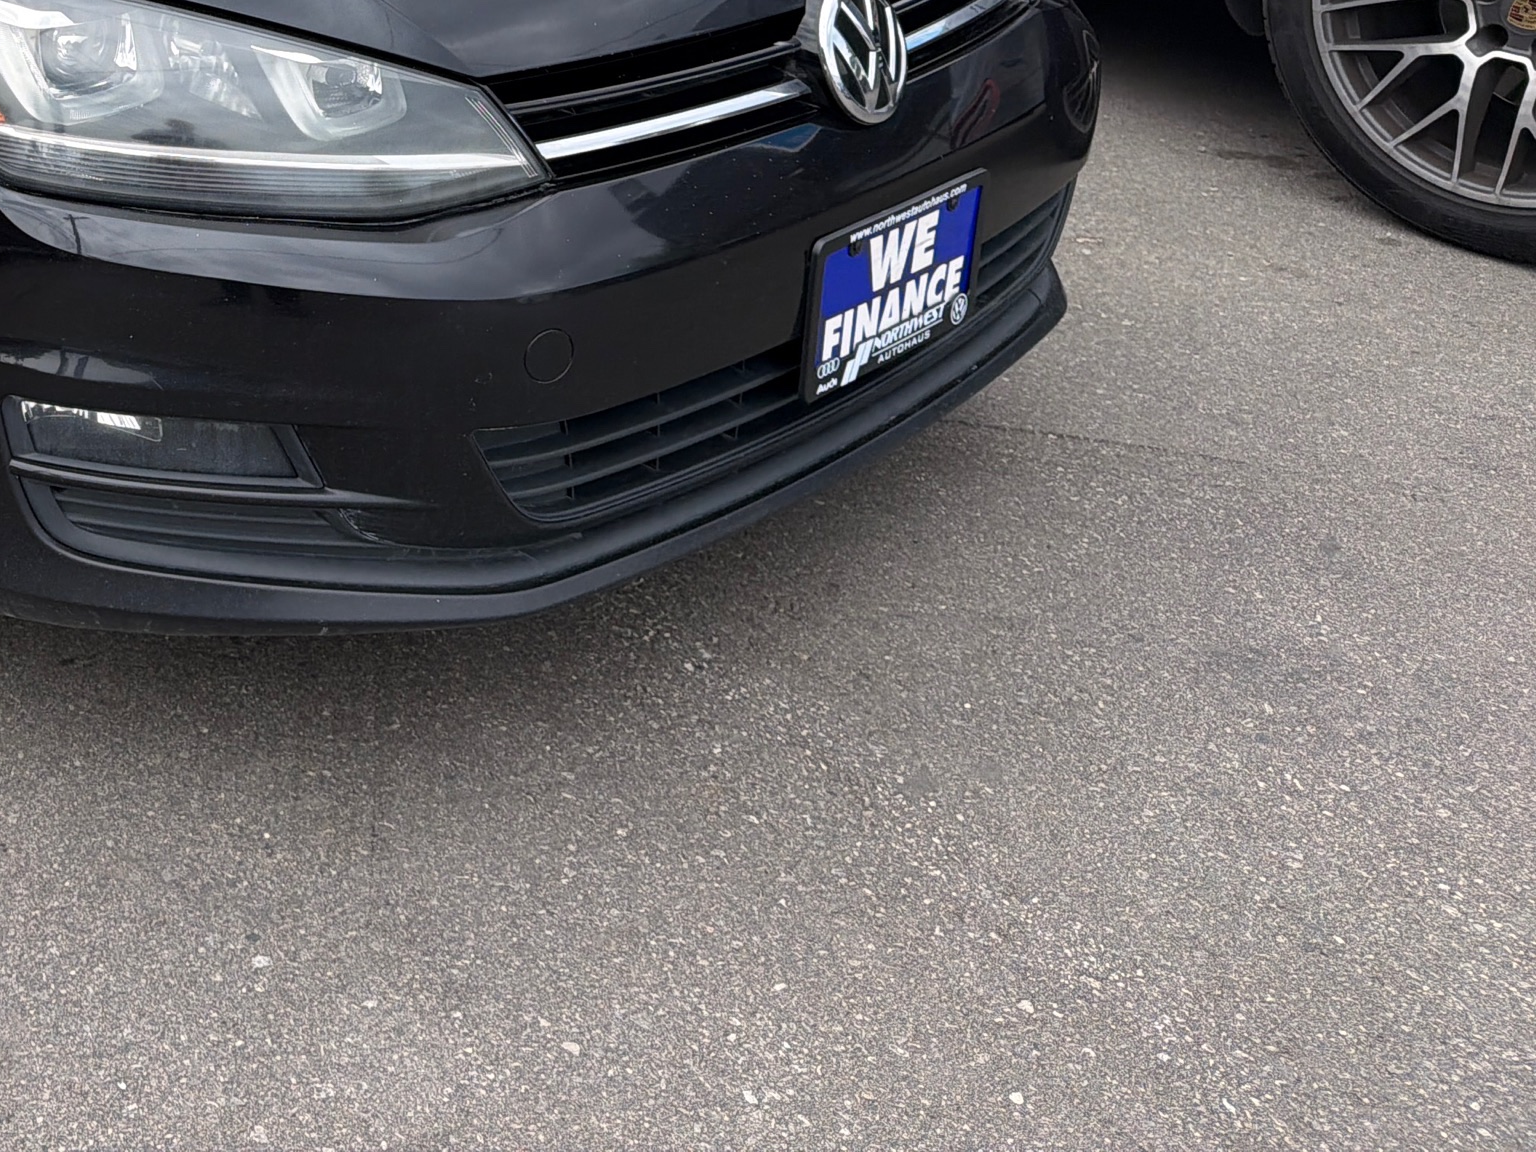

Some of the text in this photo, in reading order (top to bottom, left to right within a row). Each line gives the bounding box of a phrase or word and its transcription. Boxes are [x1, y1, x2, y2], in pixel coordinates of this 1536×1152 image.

[849, 183, 967, 243] www.northwestautohaus.com
[869, 209, 940, 292] WE
[822, 255, 965, 362] FINANCE
[872, 304, 945, 352] NORTHWEST
[877, 329, 931, 364] AUTOHAUS
[816, 377, 838, 395] Audi
